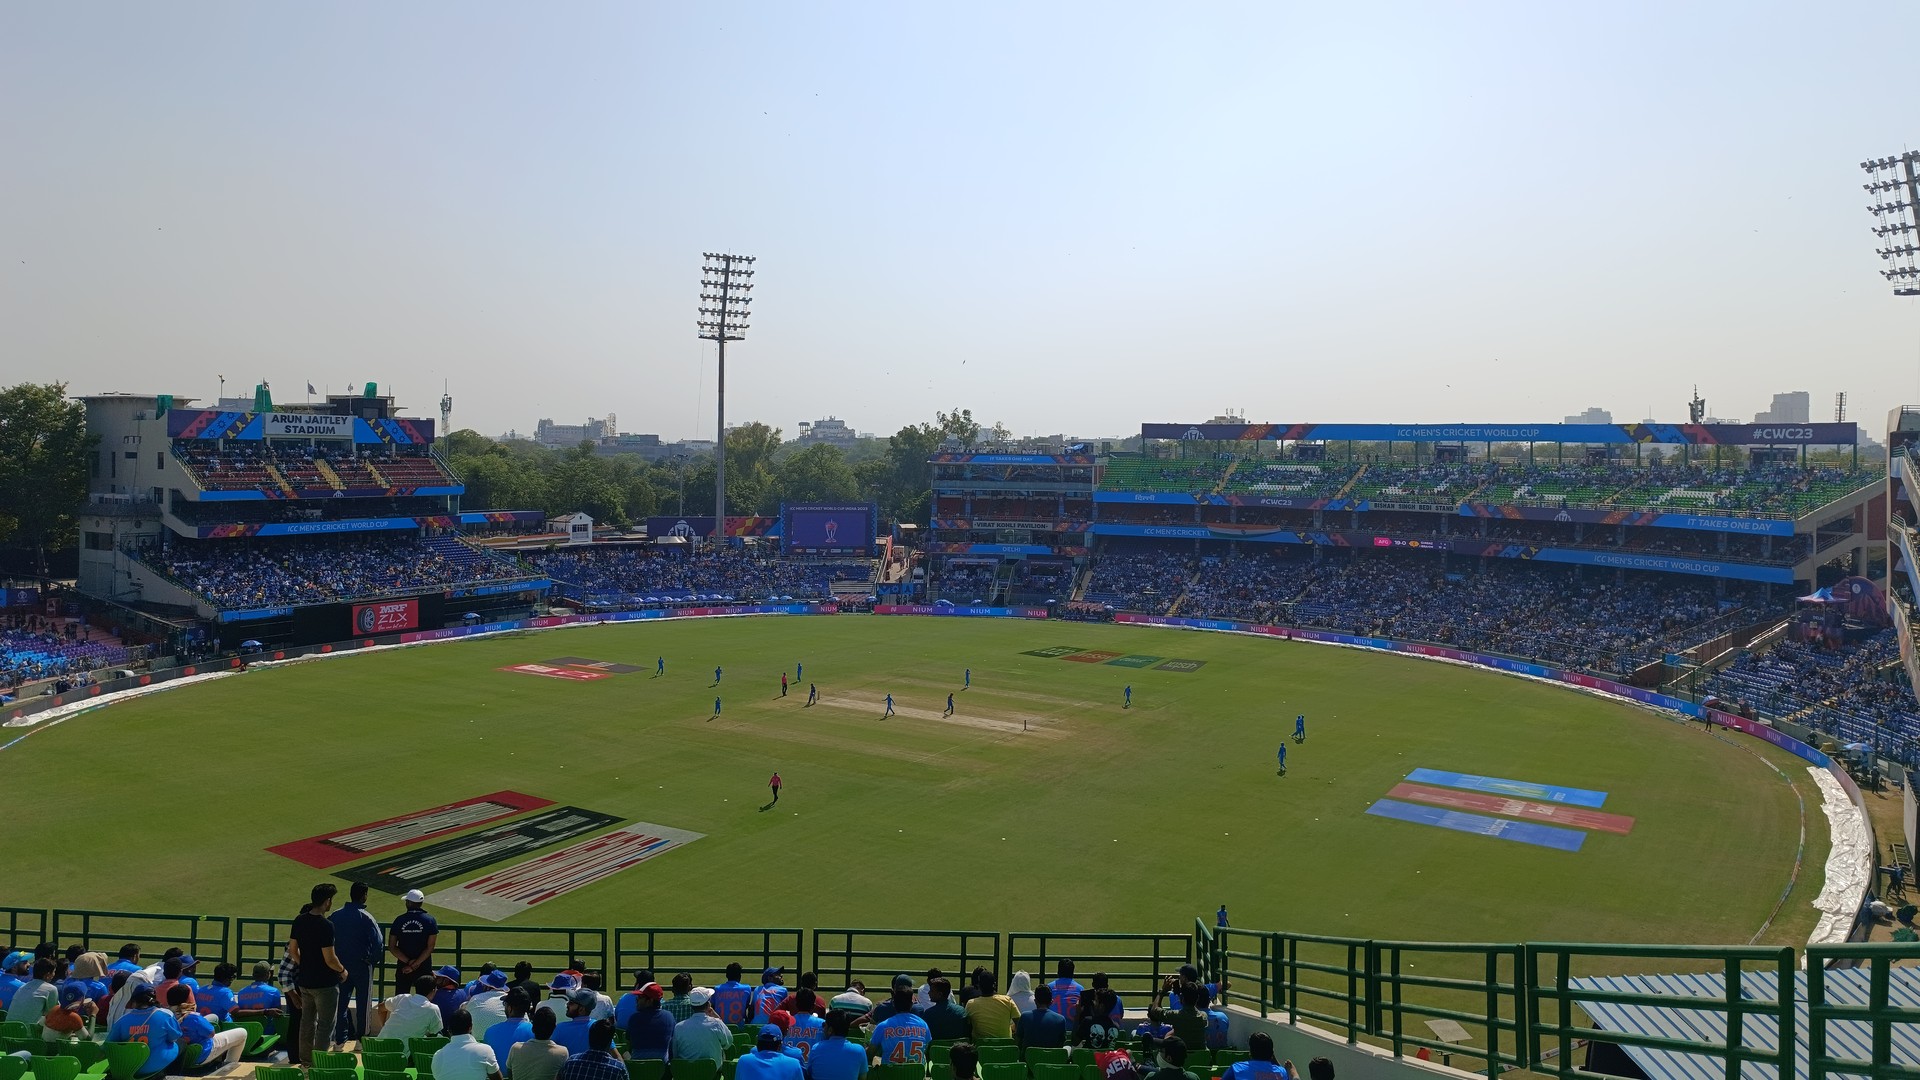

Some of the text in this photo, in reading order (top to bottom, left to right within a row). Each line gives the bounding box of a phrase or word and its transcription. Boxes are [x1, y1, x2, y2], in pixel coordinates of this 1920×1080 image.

[271, 414, 349, 425] ARUN JAITLEY
[284, 425, 336, 434] STADIUM
[1397, 428, 1540, 437] ICC MEN'S CRICKET WORLD CUP
[1752, 428, 1813, 440] #CWC23
[287, 525, 298, 533] ICC
[300, 524, 321, 532] MEN'S
[321, 523, 349, 531] CRICKET
[350, 521, 375, 529] WORLD
[1687, 518, 1772, 532] IT TAKES ONE DAY
[1155, 528, 1177, 536] MEN'S
[1177, 529, 1205, 537] CRICKET
[1594, 555, 1720, 573] ICC MEN'S CRICKET WORLD CUP
[379, 603, 408, 614] MRF
[378, 613, 408, 624] ZLX
[531, 619, 549, 627] NIUM
[484, 624, 502, 632] NIUM
[435, 630, 454, 638] NIUM
[1301, 631, 1320, 640] NIUM
[1353, 638, 1373, 646] NIUM
[1406, 645, 1426, 654] NIUM
[1459, 653, 1478, 662] NIUM
[1511, 663, 1530, 672] NIUM
[1562, 673, 1582, 684] NIUM
[1614, 685, 1632, 696] NIUM
[1664, 699, 1684, 710] NIUM
[1717, 713, 1737, 725] NIUM
[1766, 730, 1781, 743] NIUM
[1806, 749, 1821, 763] NIUM
[718, 991, 744, 1000] VIRAT
[719, 1001, 743, 1023] 18
[788, 1026, 819, 1039] IRAT
[884, 1026, 927, 1038] ROHIT
[889, 1040, 924, 1065] 45
